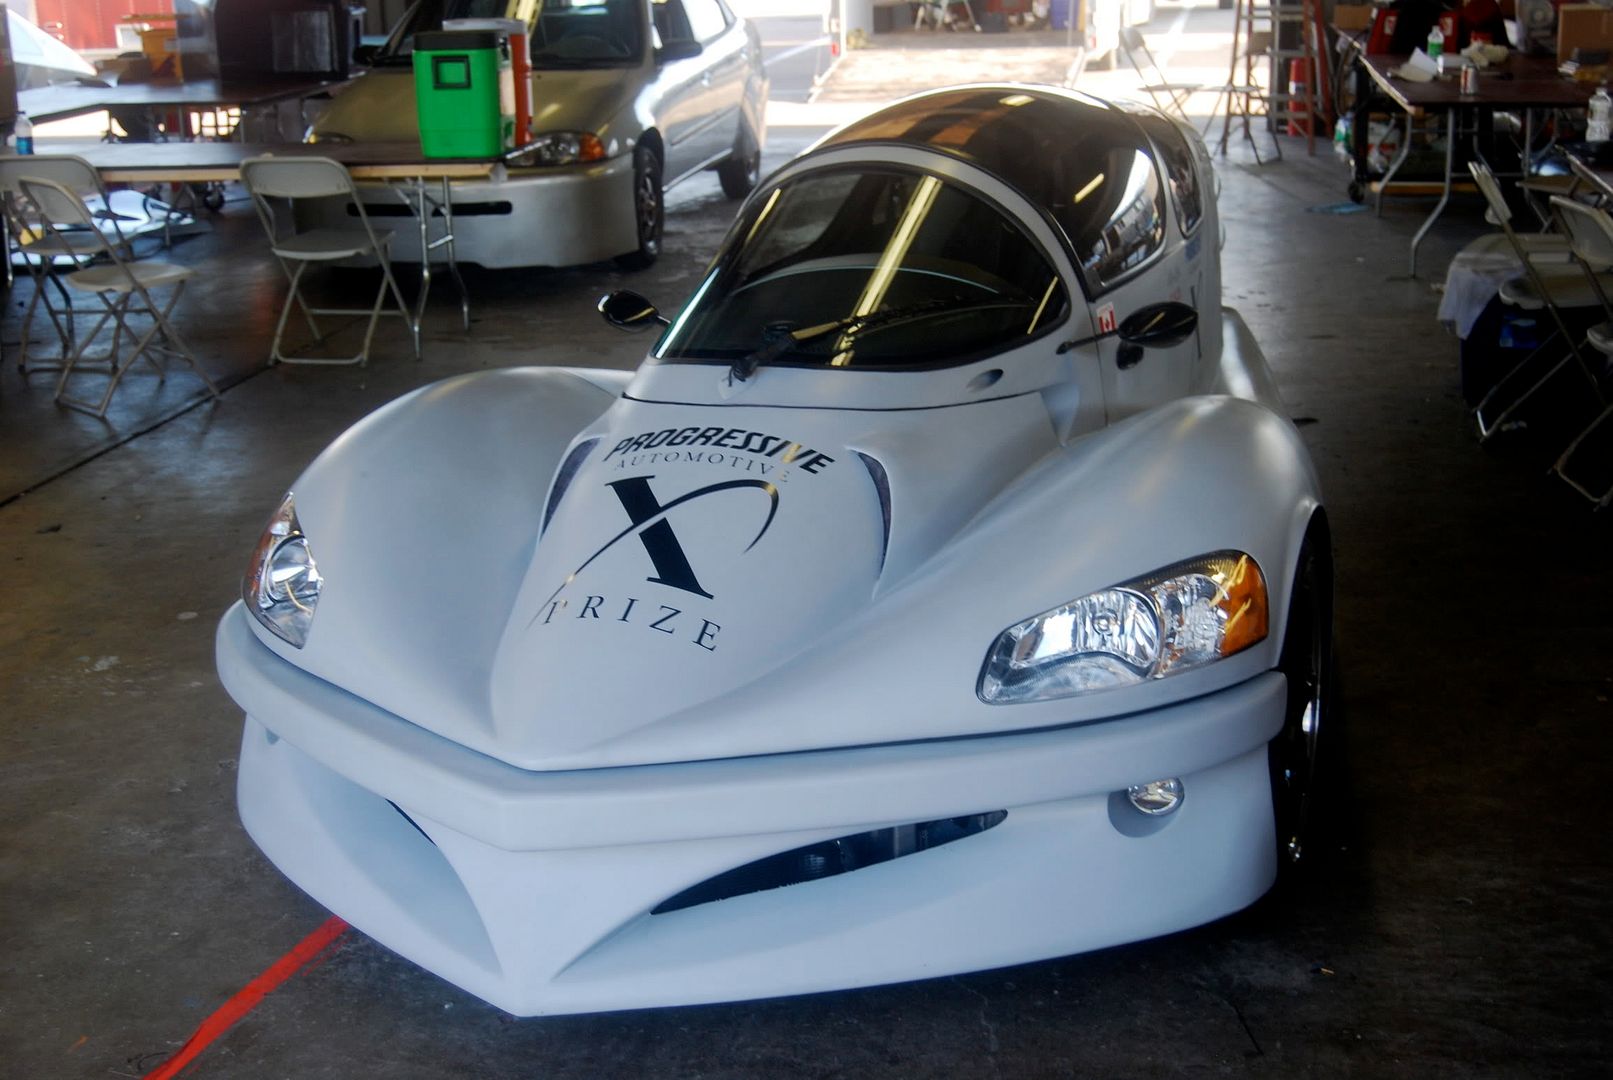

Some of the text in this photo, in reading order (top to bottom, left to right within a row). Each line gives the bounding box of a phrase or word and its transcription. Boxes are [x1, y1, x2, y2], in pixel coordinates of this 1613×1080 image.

[602, 427, 835, 475] PROGRESSIVE
[614, 451, 790, 483] AUTOMOTIVE
[542, 595, 721, 651] PRIZE
